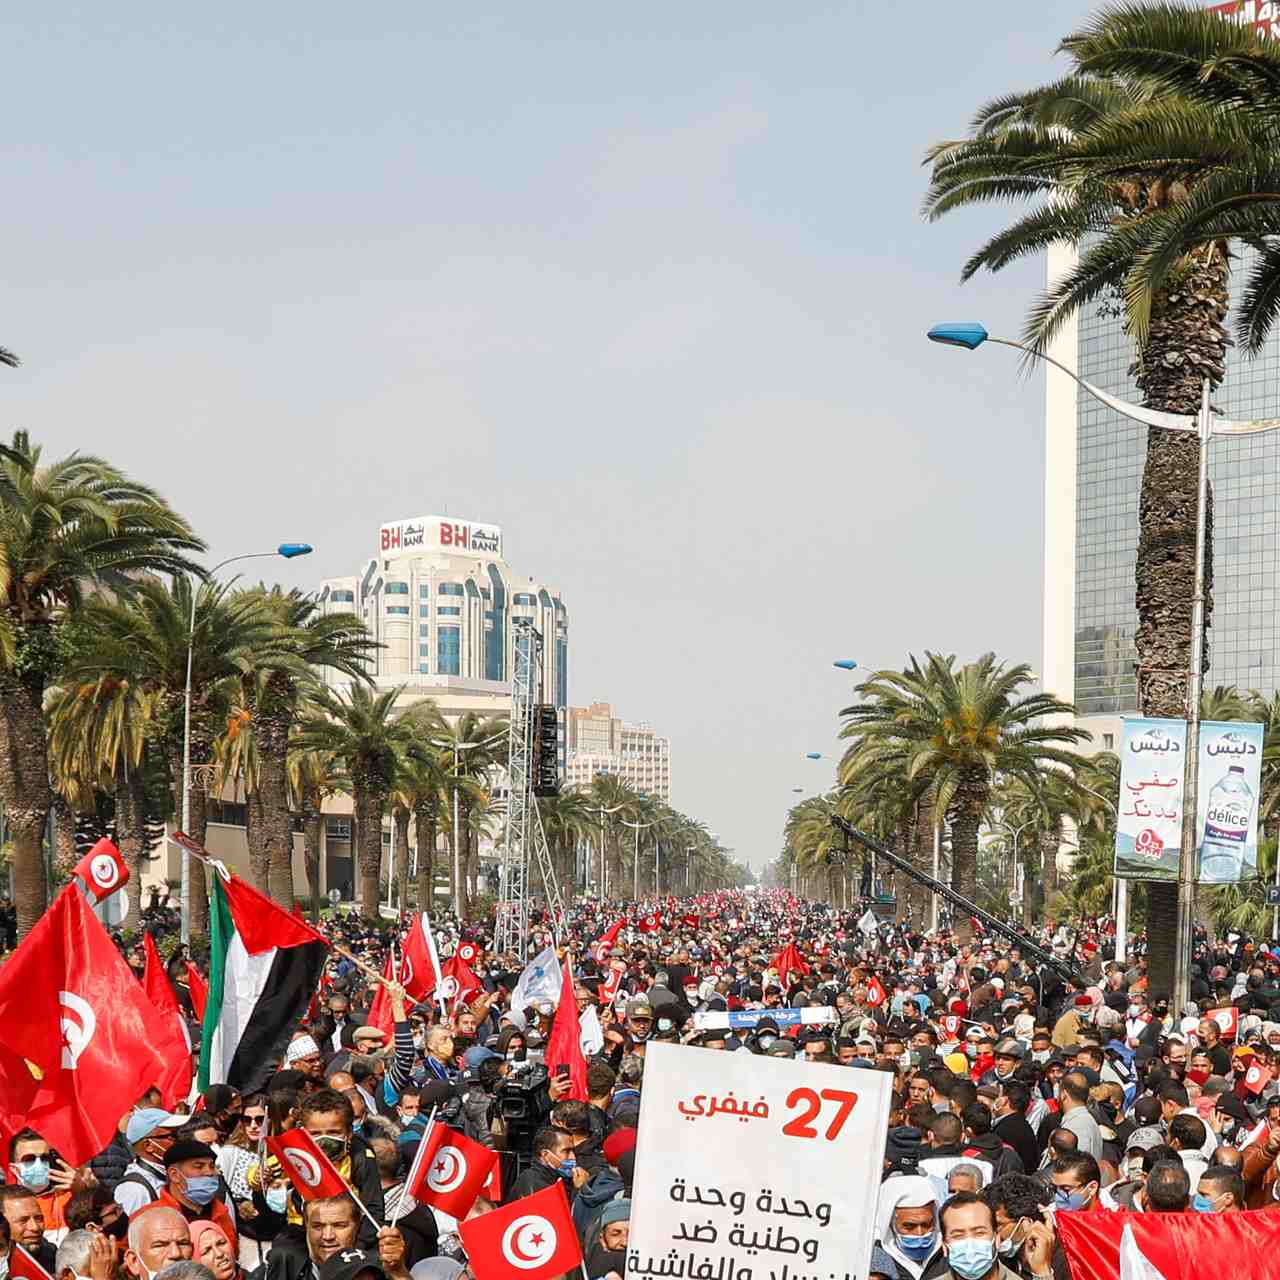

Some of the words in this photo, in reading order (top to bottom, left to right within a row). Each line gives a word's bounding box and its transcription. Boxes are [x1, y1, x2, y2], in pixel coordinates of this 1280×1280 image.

[381, 527, 400, 550] BH
[404, 536, 423, 547] BANK
[440, 523, 467, 548] BH
[471, 540, 498, 552] BANK
[1130, 738, 1180, 755] دليس
[1207, 742, 1257, 758] دليس
[1126, 771, 1178, 795] صفي
[678, 1091, 769, 1122] فيفري
[782, 1087, 859, 1141] 27
[669, 1177, 746, 1216] وحدة
[755, 1188, 832, 1228] وحدة
[672, 1219, 718, 1244] ضد
[728, 1222, 820, 1263] وطنية
